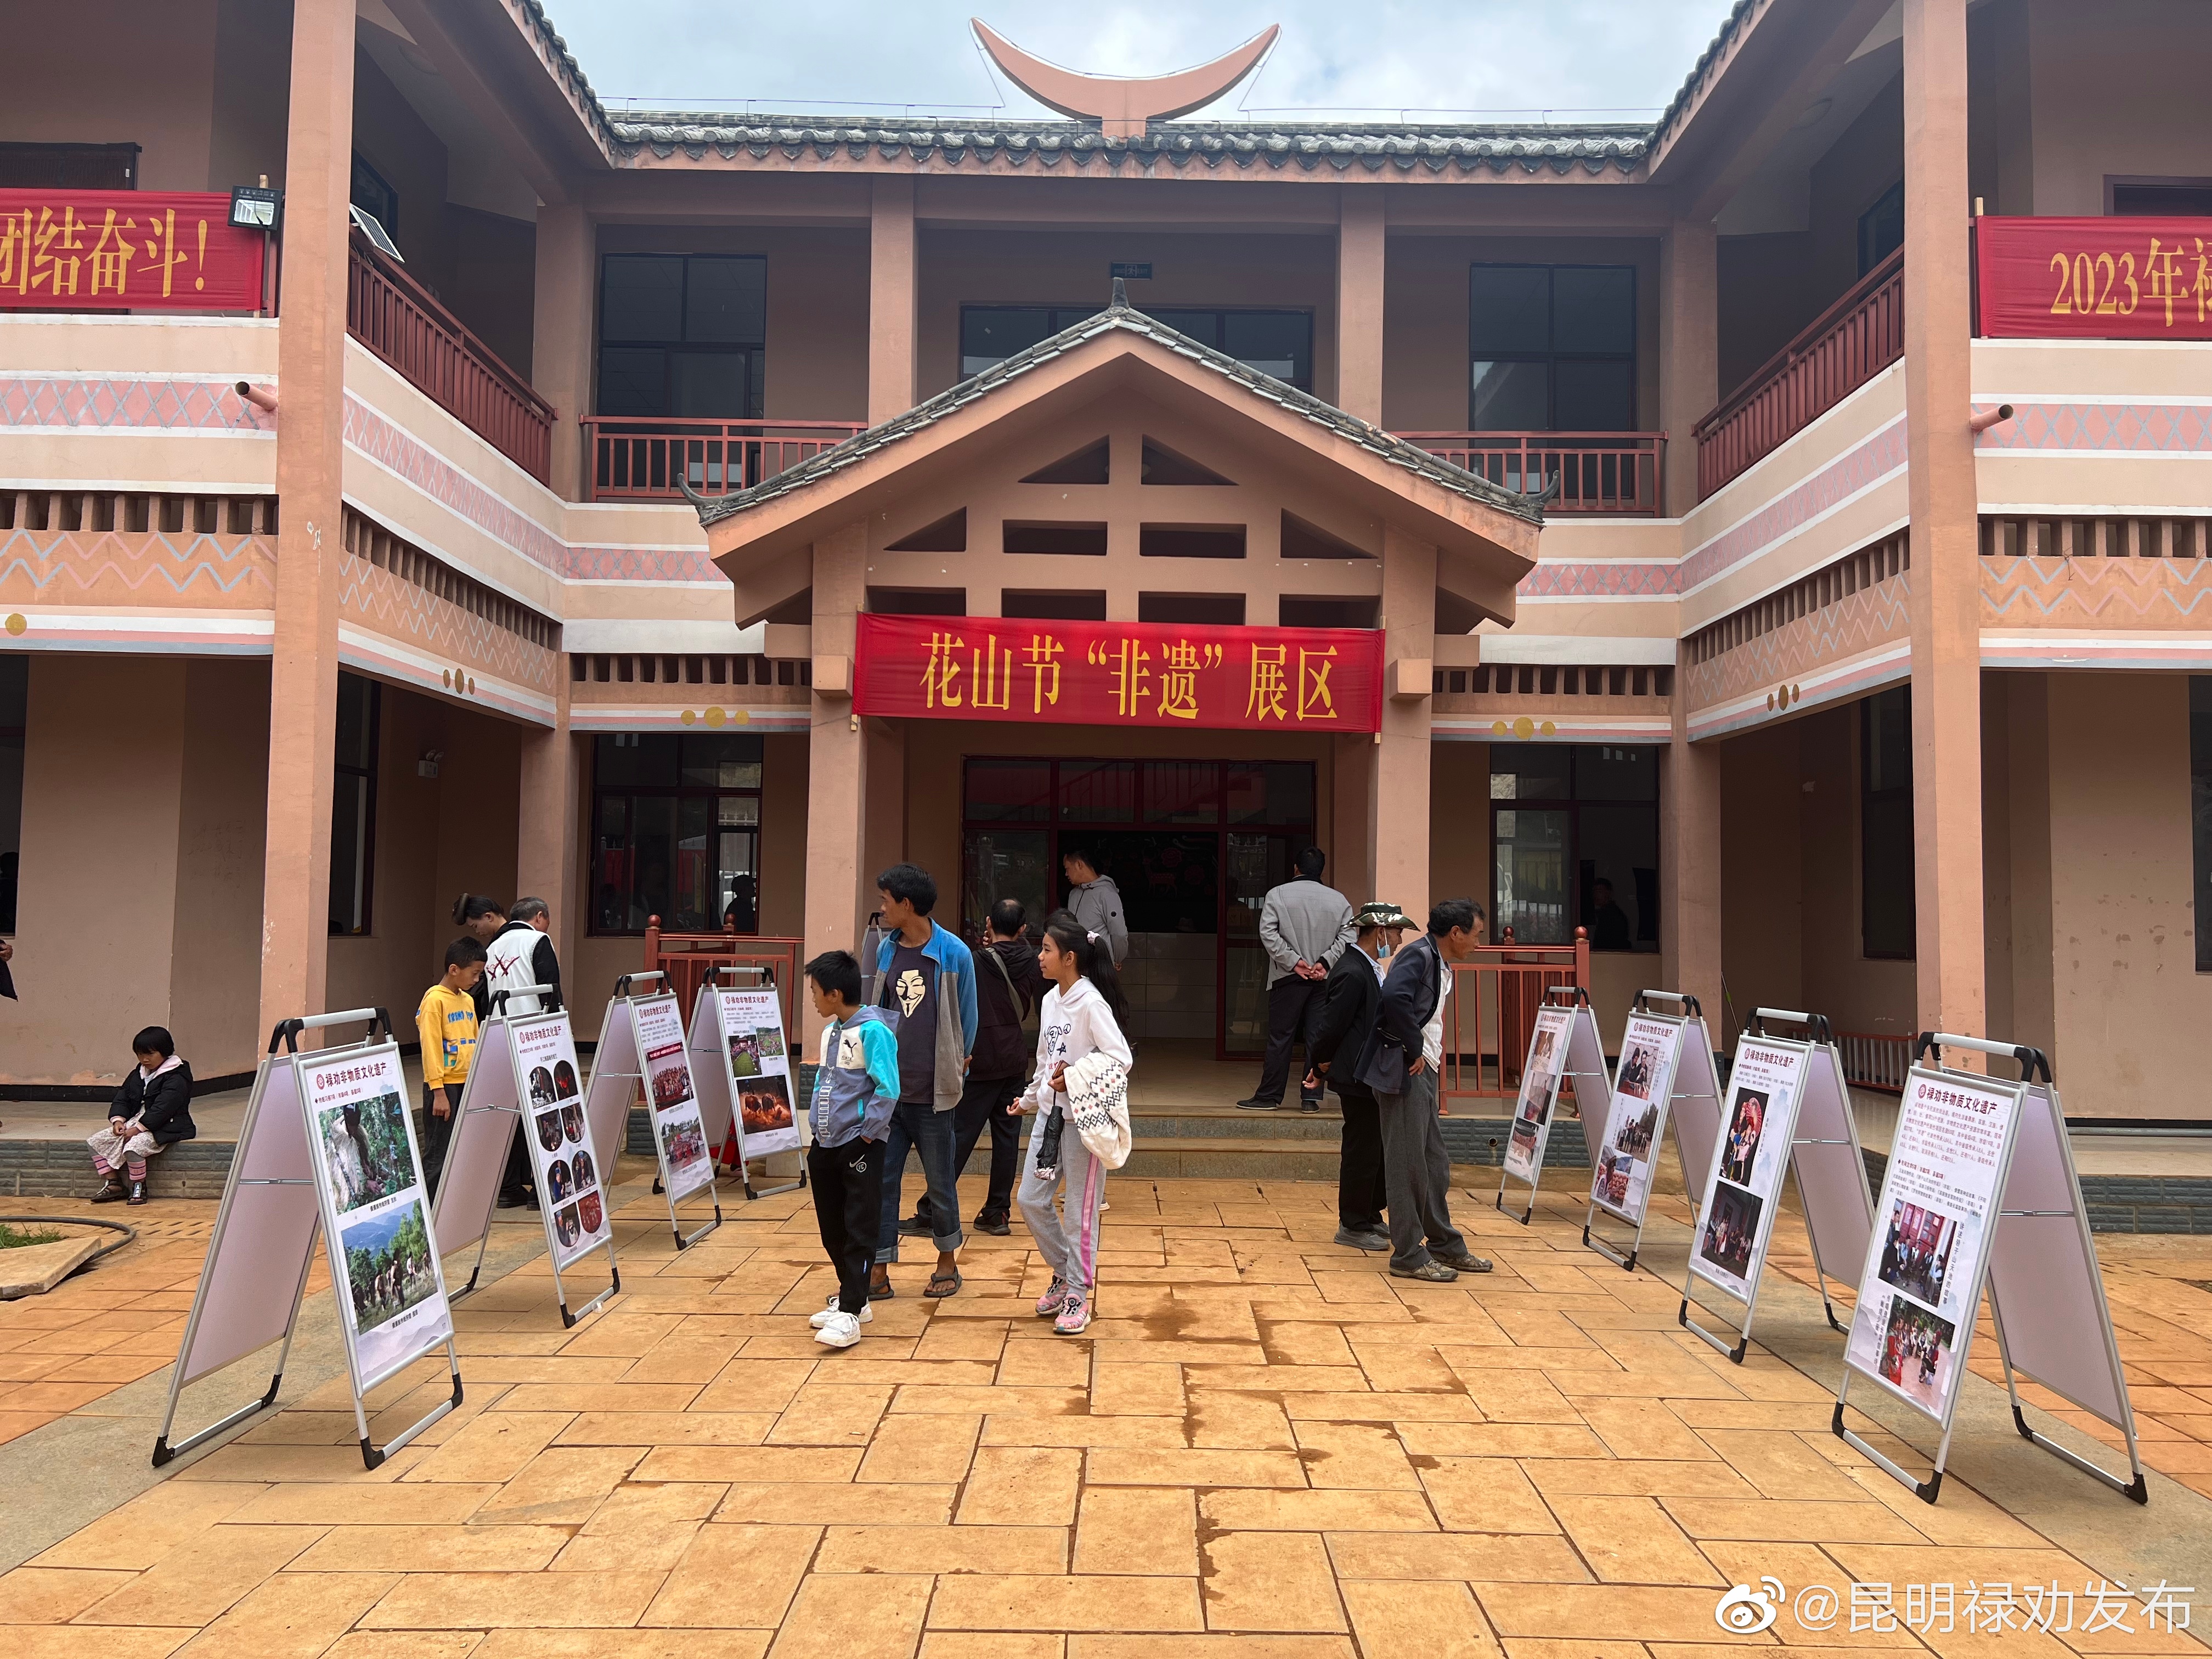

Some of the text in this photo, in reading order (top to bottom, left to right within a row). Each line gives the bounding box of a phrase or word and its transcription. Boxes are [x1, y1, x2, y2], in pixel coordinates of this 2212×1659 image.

[0, 206, 207, 297] 团结奋斗!
[919, 631, 1338, 721] 花山节“非遗”展区
[326, 1062, 387, 1087] 禄劝非物质文化遗产
[1927, 1087, 1997, 1115] 禄劝非物质文化遗产
